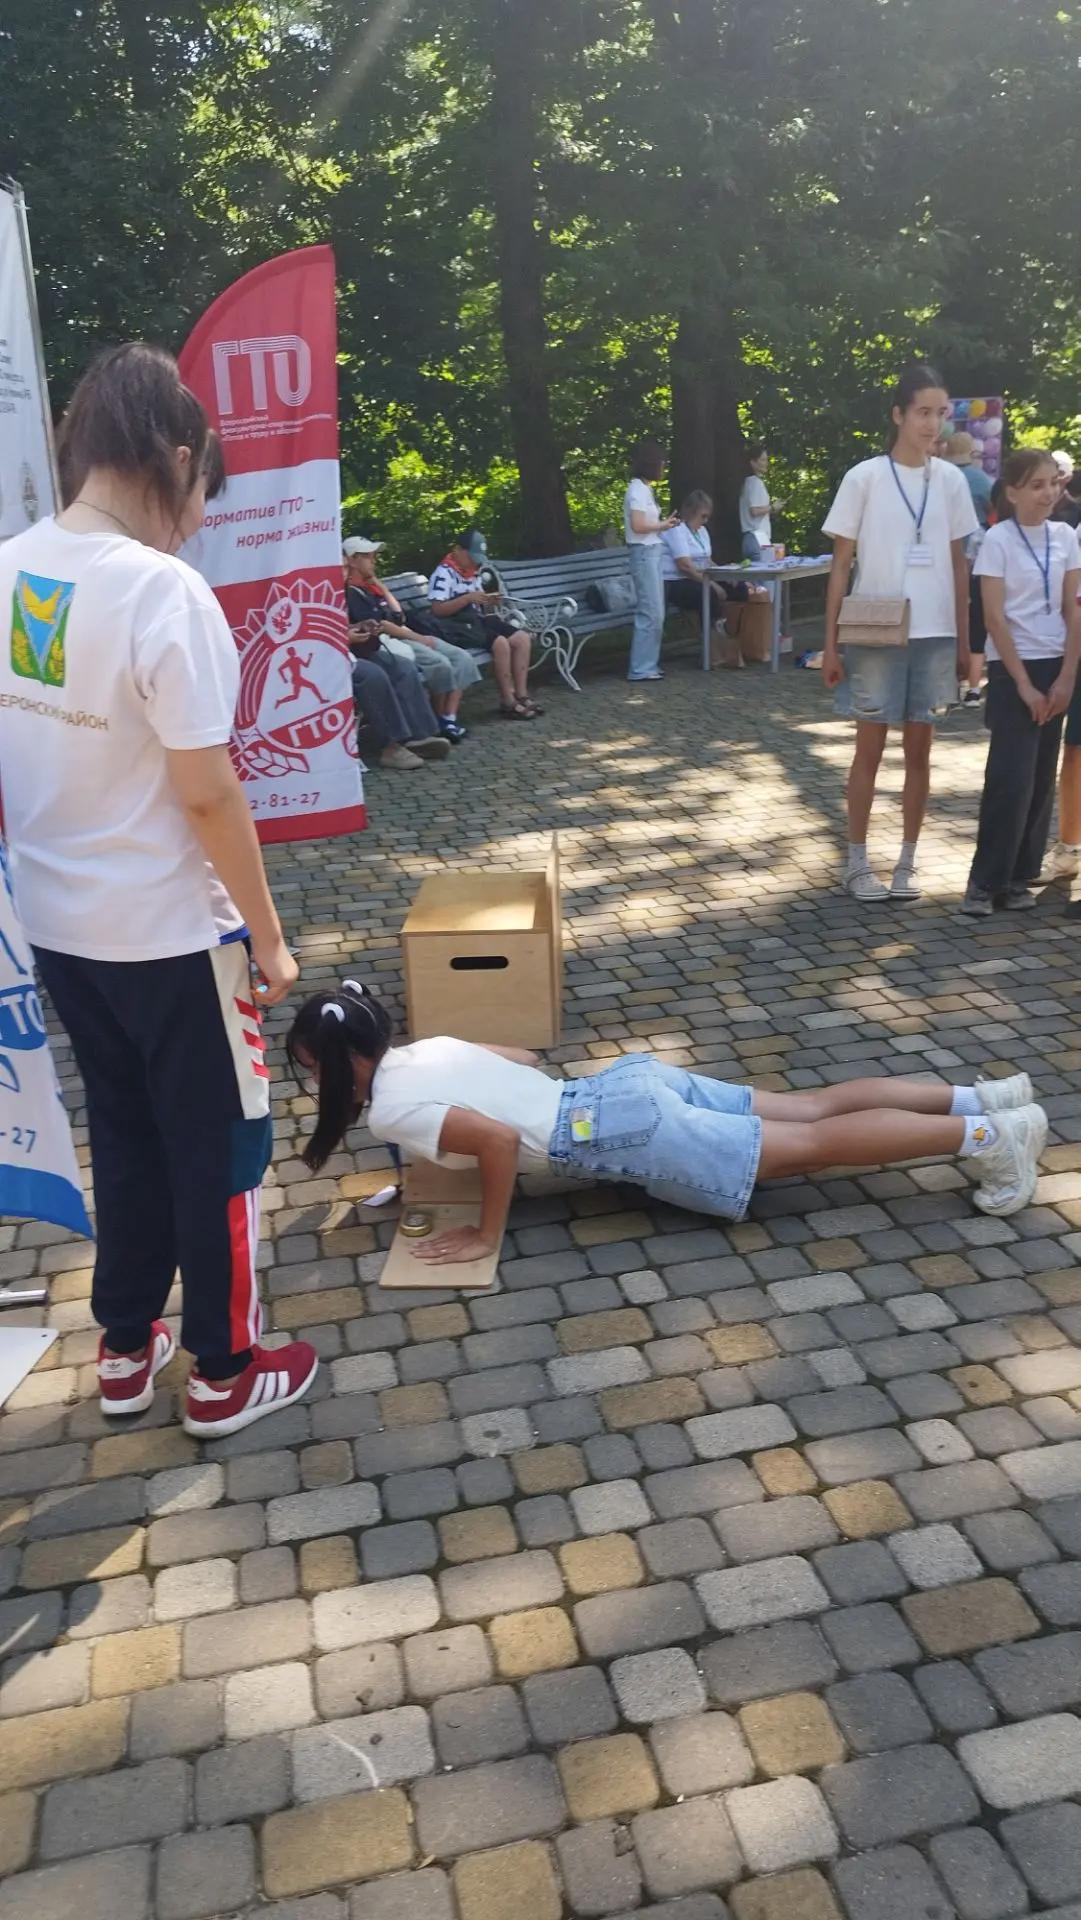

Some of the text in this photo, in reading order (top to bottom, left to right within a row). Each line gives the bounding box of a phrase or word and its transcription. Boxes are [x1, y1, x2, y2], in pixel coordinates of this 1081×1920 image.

[212, 334, 312, 415] ГТО
[279, 496, 304, 516] ГТО
[236, 516, 336, 549] норма жизни!
[288, 708, 345, 747] ГТО
[0, 990, 46, 1040] ТО
